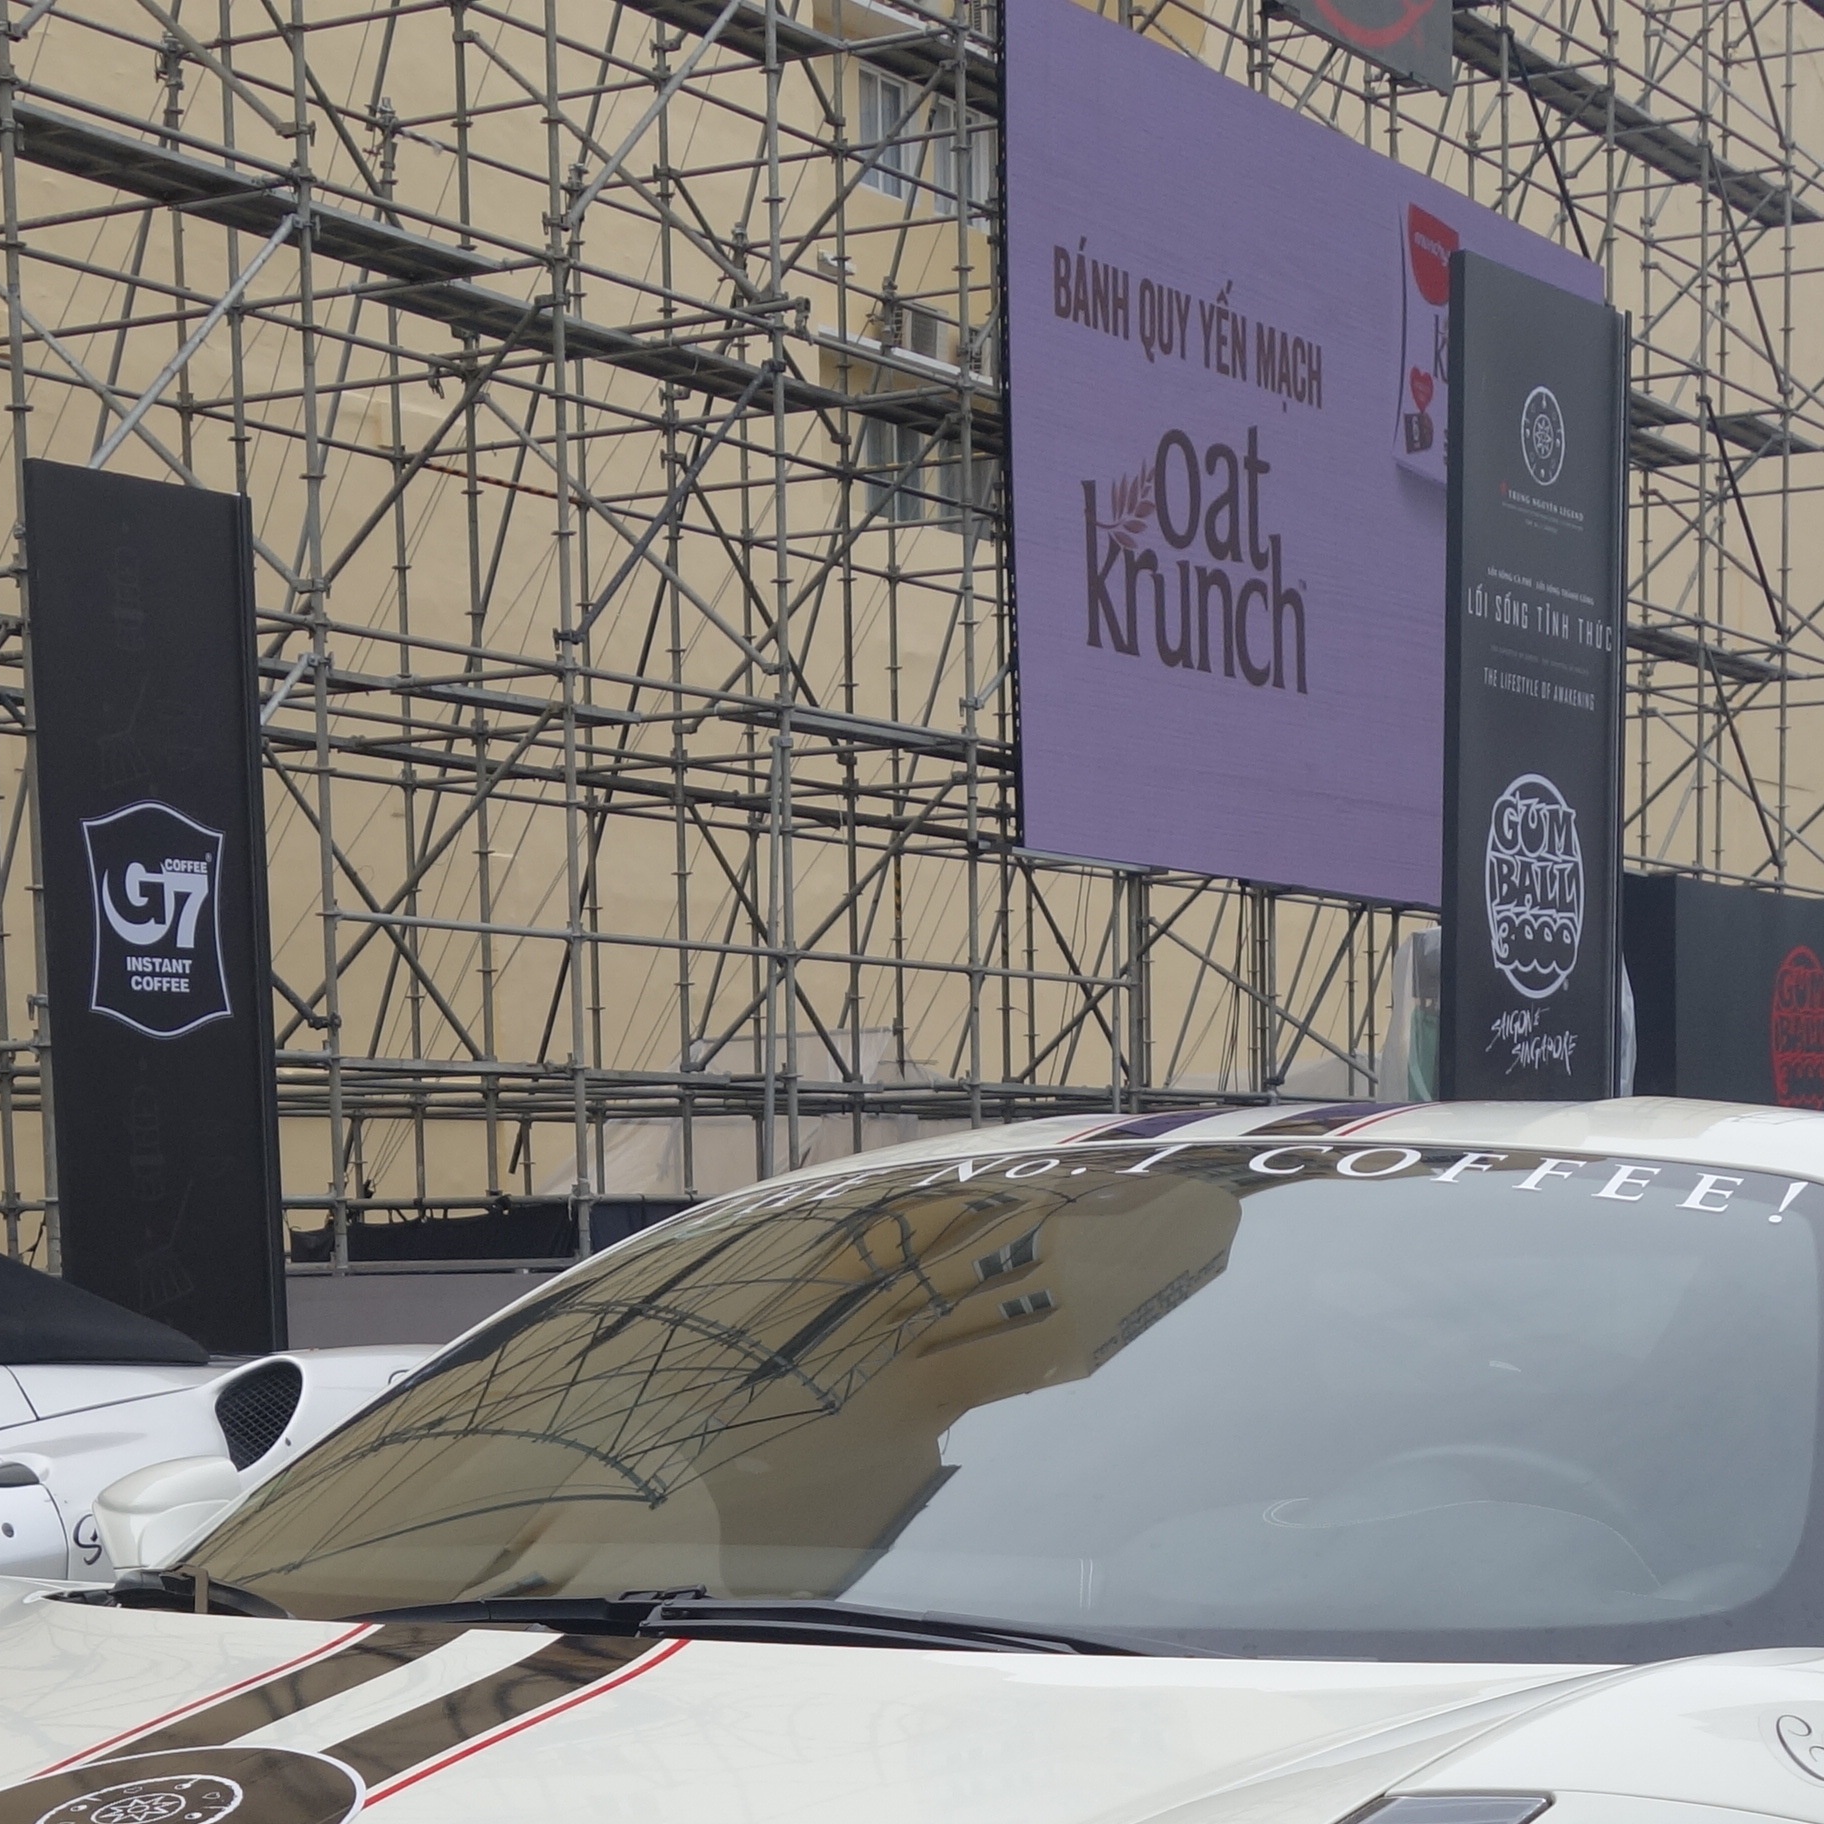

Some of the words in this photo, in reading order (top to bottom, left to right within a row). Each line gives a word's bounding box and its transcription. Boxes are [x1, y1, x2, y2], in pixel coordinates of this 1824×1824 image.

[1053, 235, 1129, 341] BÁNH
[1139, 277, 1191, 364] QUY
[1199, 279, 1247, 382] YẾN
[1256, 321, 1322, 413] MẠCH
[1467, 583, 1488, 618] LỐI
[1495, 591, 1529, 629] SỐNG
[1483, 667, 1498, 688] THE
[1500, 672, 1539, 698] LIFESTYLE
[1541, 681, 1551, 700] OF
[1491, 791, 1576, 860] GUM
[164, 858, 208, 874] COFFEE
[1490, 852, 1576, 912] BALL
[102, 861, 209, 949] G7
[126, 956, 192, 974] INSTANT
[1491, 911, 1577, 975] 3000
[131, 975, 190, 992] COFFEE
[909, 1156, 1087, 1188] No.
[1249, 1145, 1809, 1224] COFFEE!
